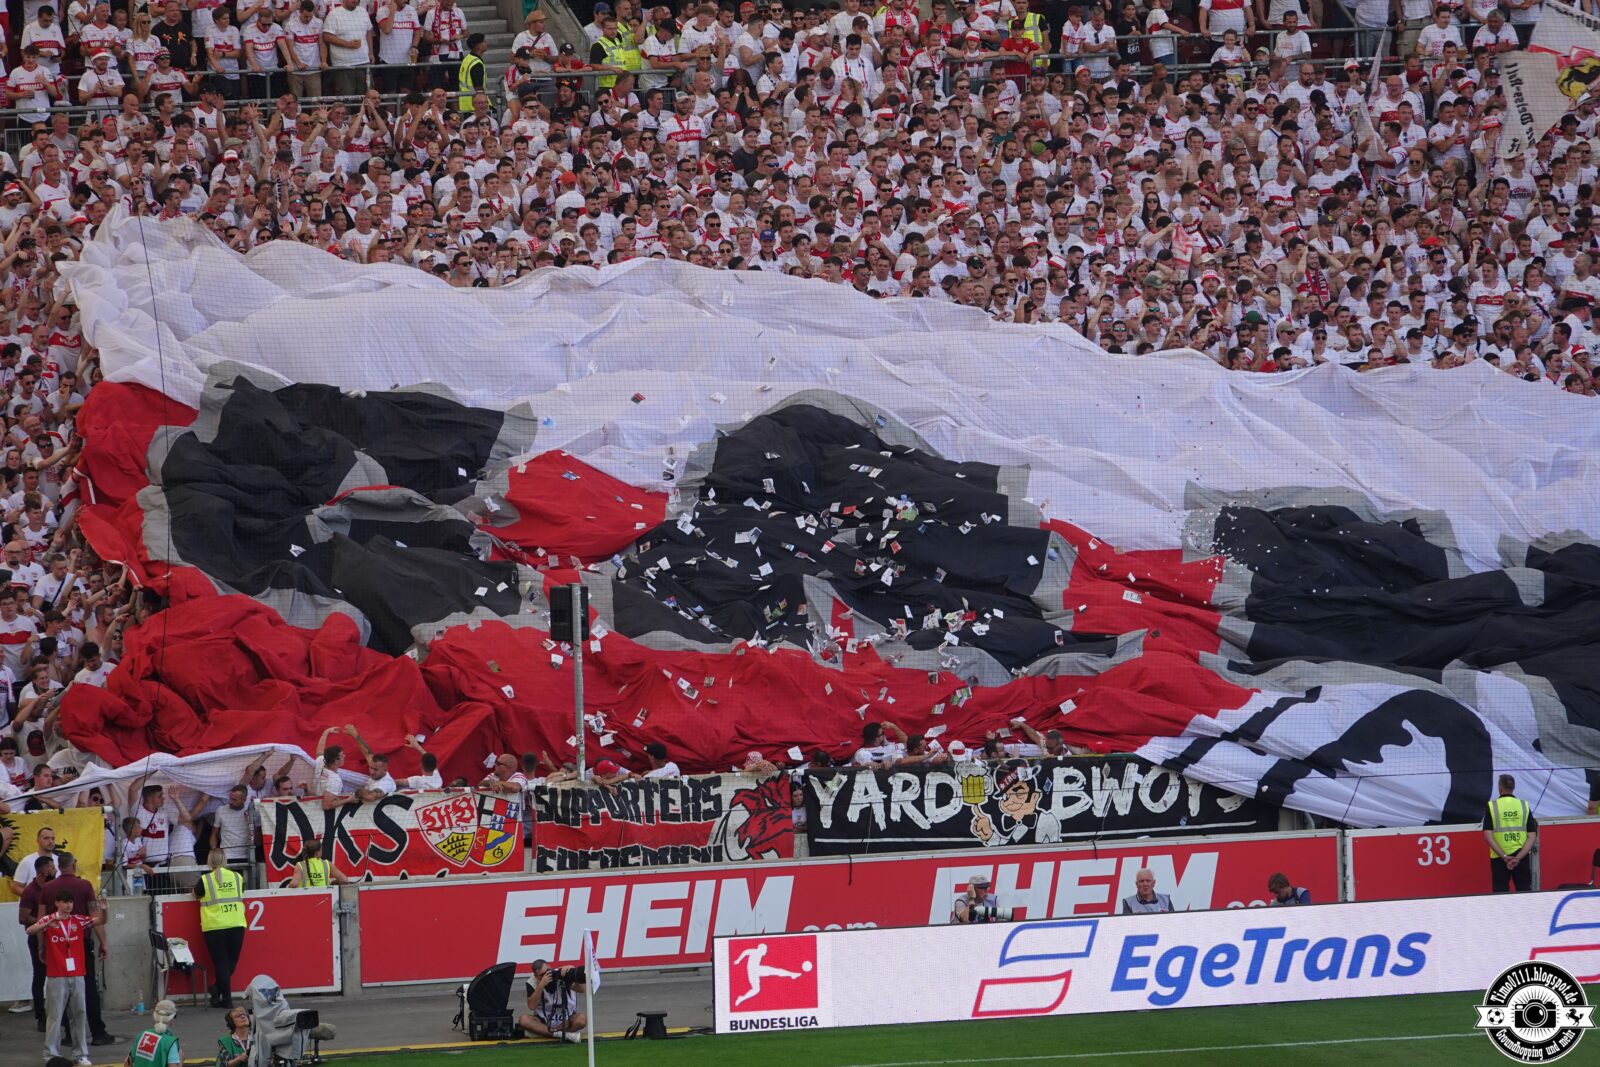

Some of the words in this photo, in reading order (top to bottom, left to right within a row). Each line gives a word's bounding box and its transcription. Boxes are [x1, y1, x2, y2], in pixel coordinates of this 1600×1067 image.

[534, 774, 723, 828] SUPPORTERS
[808, 769, 963, 831] YARD
[269, 794, 415, 871] DKS
[1417, 835, 1451, 866] 33
[220, 903, 238, 913] 1371
[496, 875, 795, 965] EHEIM
[1110, 926, 1432, 1006] EgeTrans
[729, 1015, 819, 1031] BUNDESLIGA
